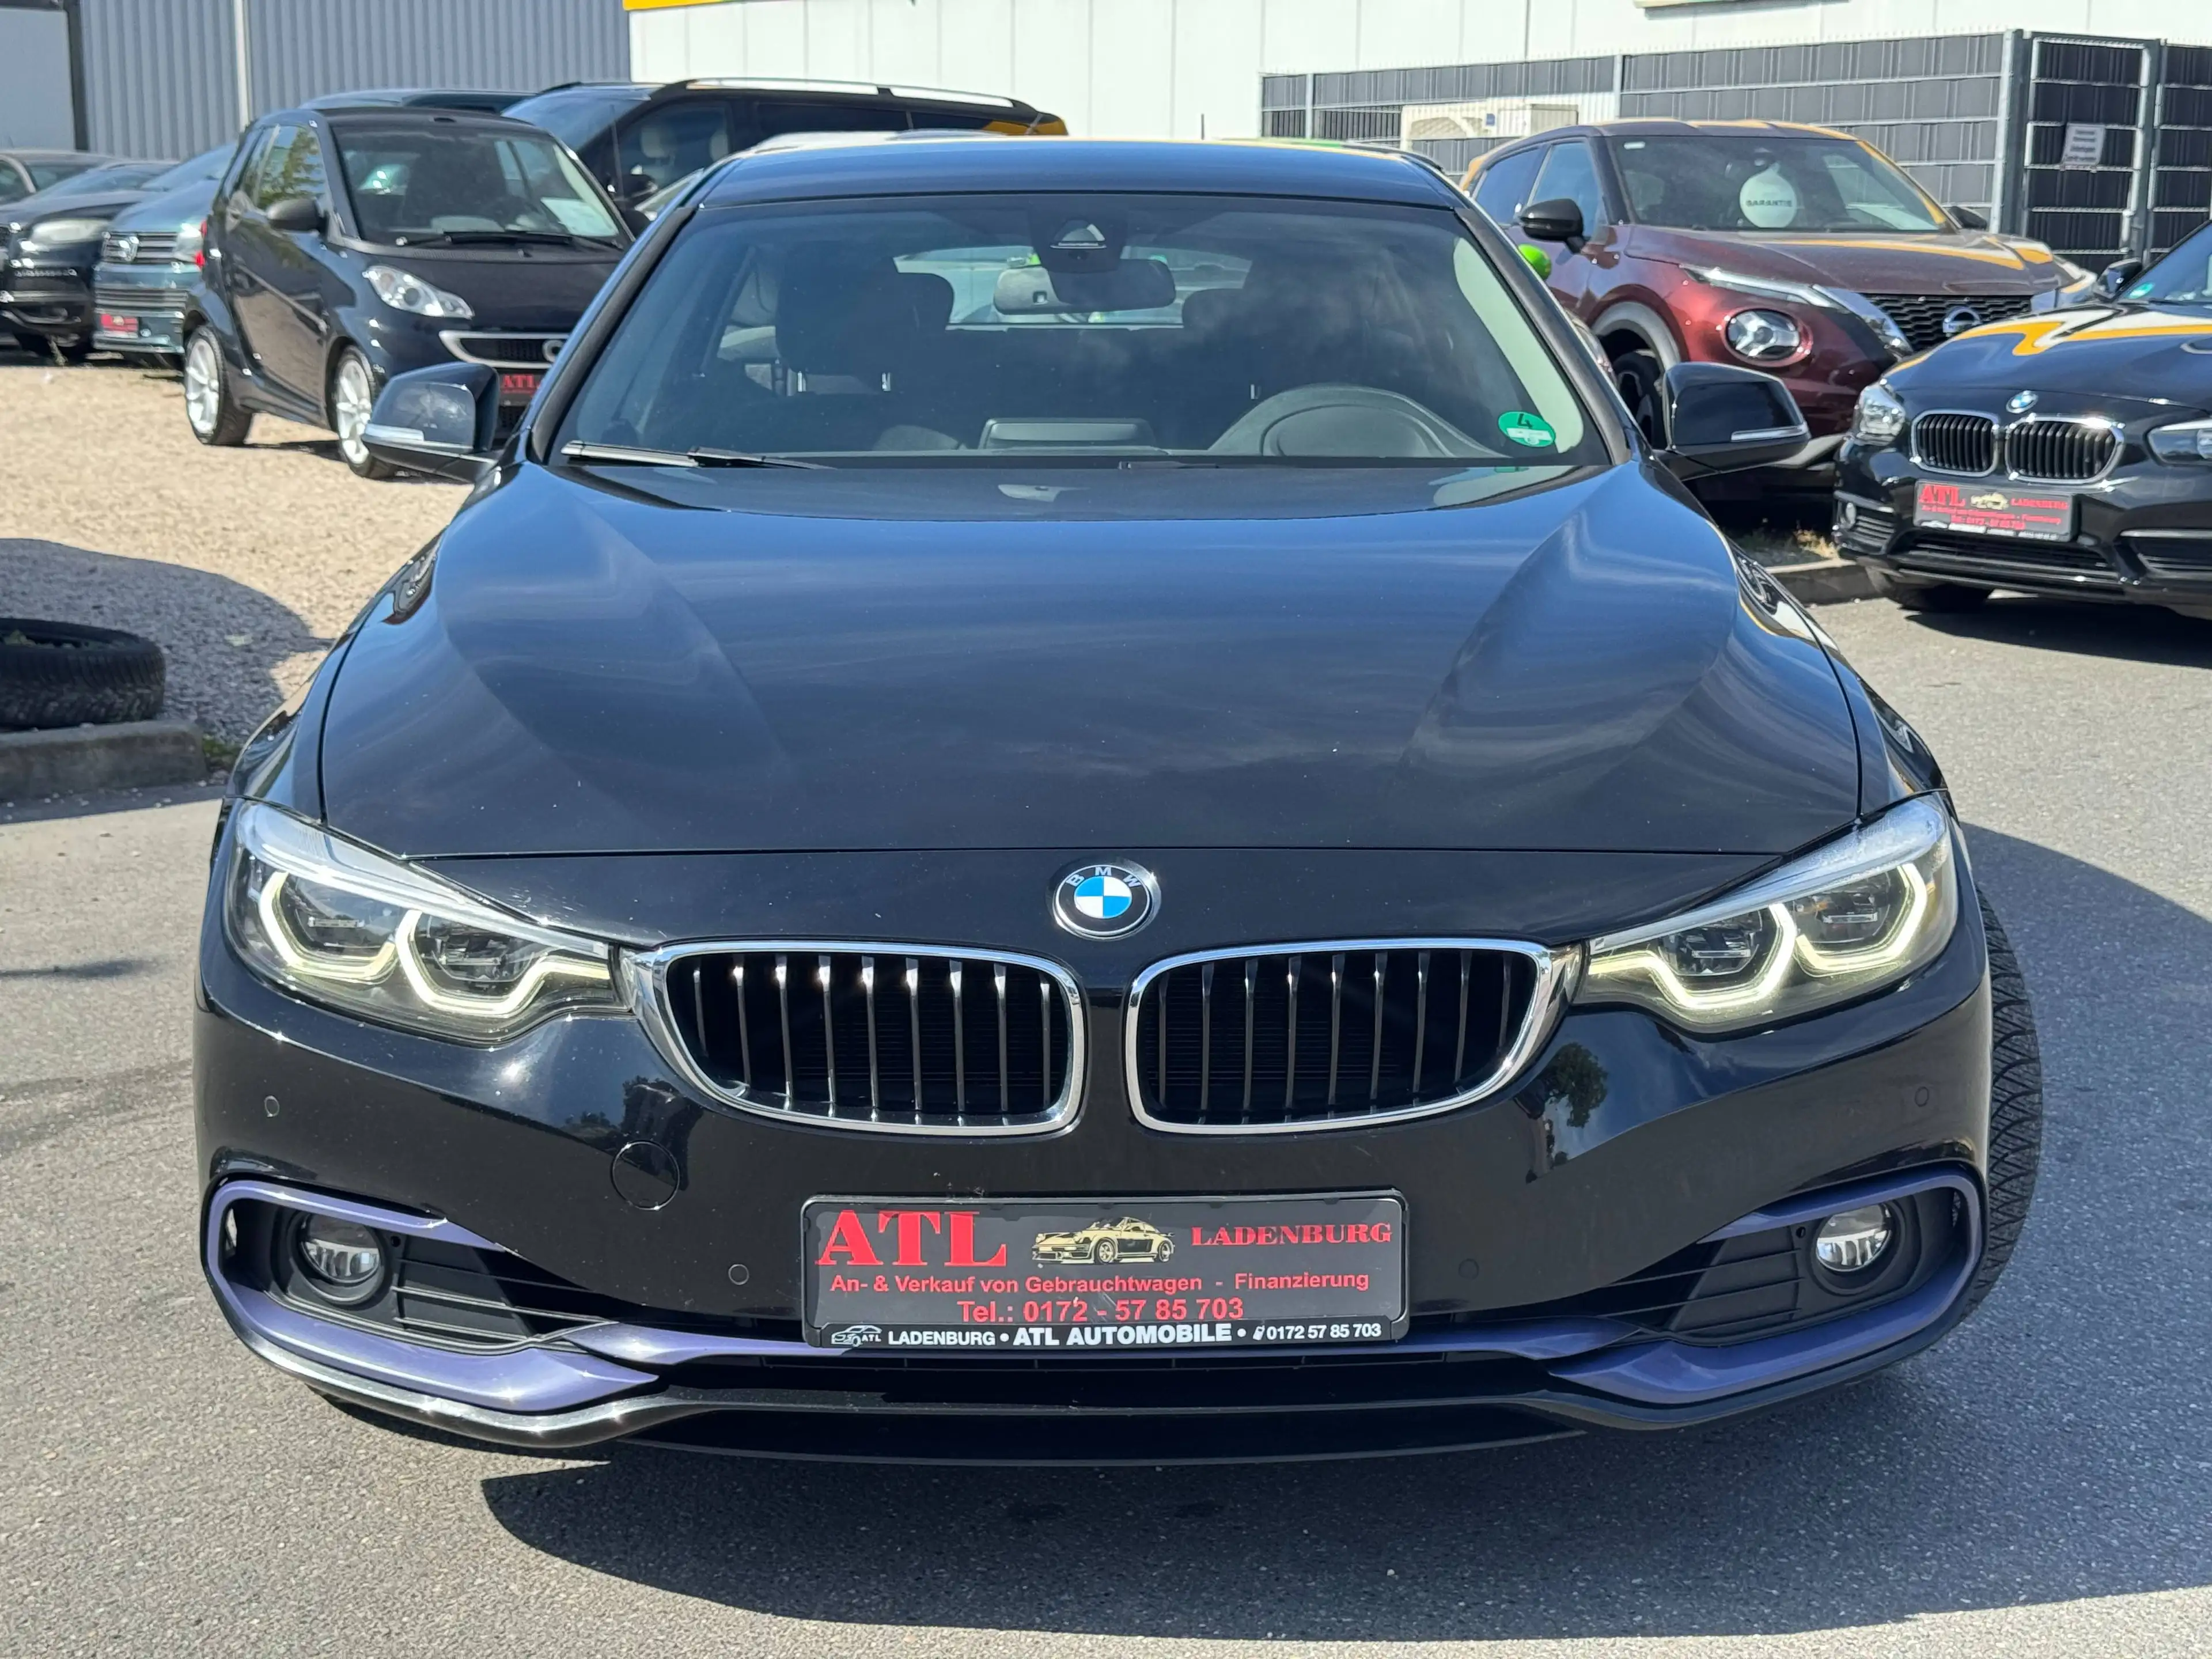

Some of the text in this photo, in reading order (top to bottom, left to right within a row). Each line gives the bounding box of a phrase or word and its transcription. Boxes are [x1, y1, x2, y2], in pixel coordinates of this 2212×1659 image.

[1517, 413, 1533, 429] 4
[1919, 484, 1965, 506] ATL
[1066, 866, 1142, 888] BMW
[815, 1210, 1392, 1267] ATL LADENBURG
[830, 1274, 868, 1292] An-
[873, 1274, 889, 1292] &
[895, 1275, 976, 1293] Verkauf
[980, 1278, 1018, 1293] von
[1025, 1275, 1202, 1296] Gebrauchtwagen
[1234, 1271, 1370, 1291] Finanzierung
[956, 1300, 1013, 1323] Tel.:
[1022, 1299, 1088, 1323] 0172
[1115, 1298, 1147, 1321] 57
[1155, 1298, 1187, 1321] 85
[1195, 1297, 1244, 1320] 703
[861, 1333, 882, 1342] ATL
[888, 1323, 1382, 1346] LADENBURG ATL AUTOMOBILE 0172 57 85 703
